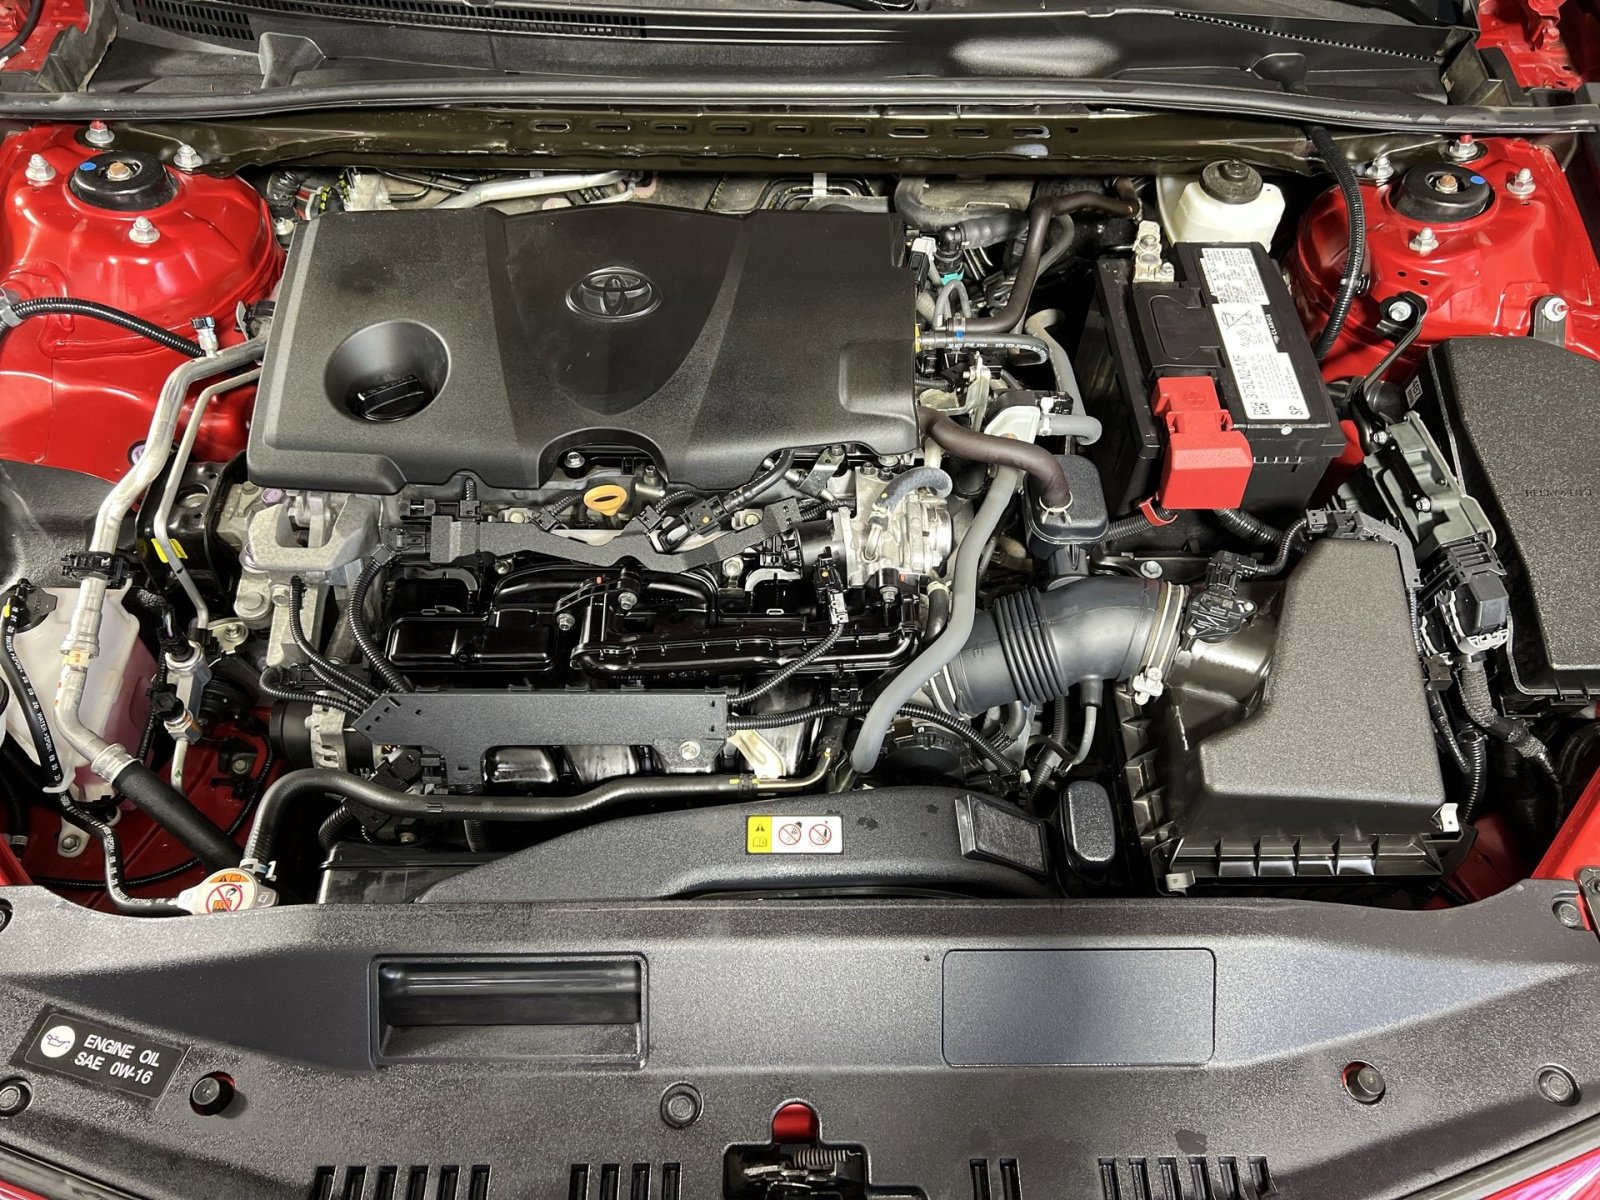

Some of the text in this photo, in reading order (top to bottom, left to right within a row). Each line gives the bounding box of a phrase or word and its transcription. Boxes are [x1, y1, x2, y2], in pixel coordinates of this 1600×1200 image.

[1289, 405, 1303, 416] SP
[37, 711, 48, 732] WATER
[83, 1033, 160, 1068] ENGINE OIL
[74, 1051, 153, 1085] SAE 0W-16
